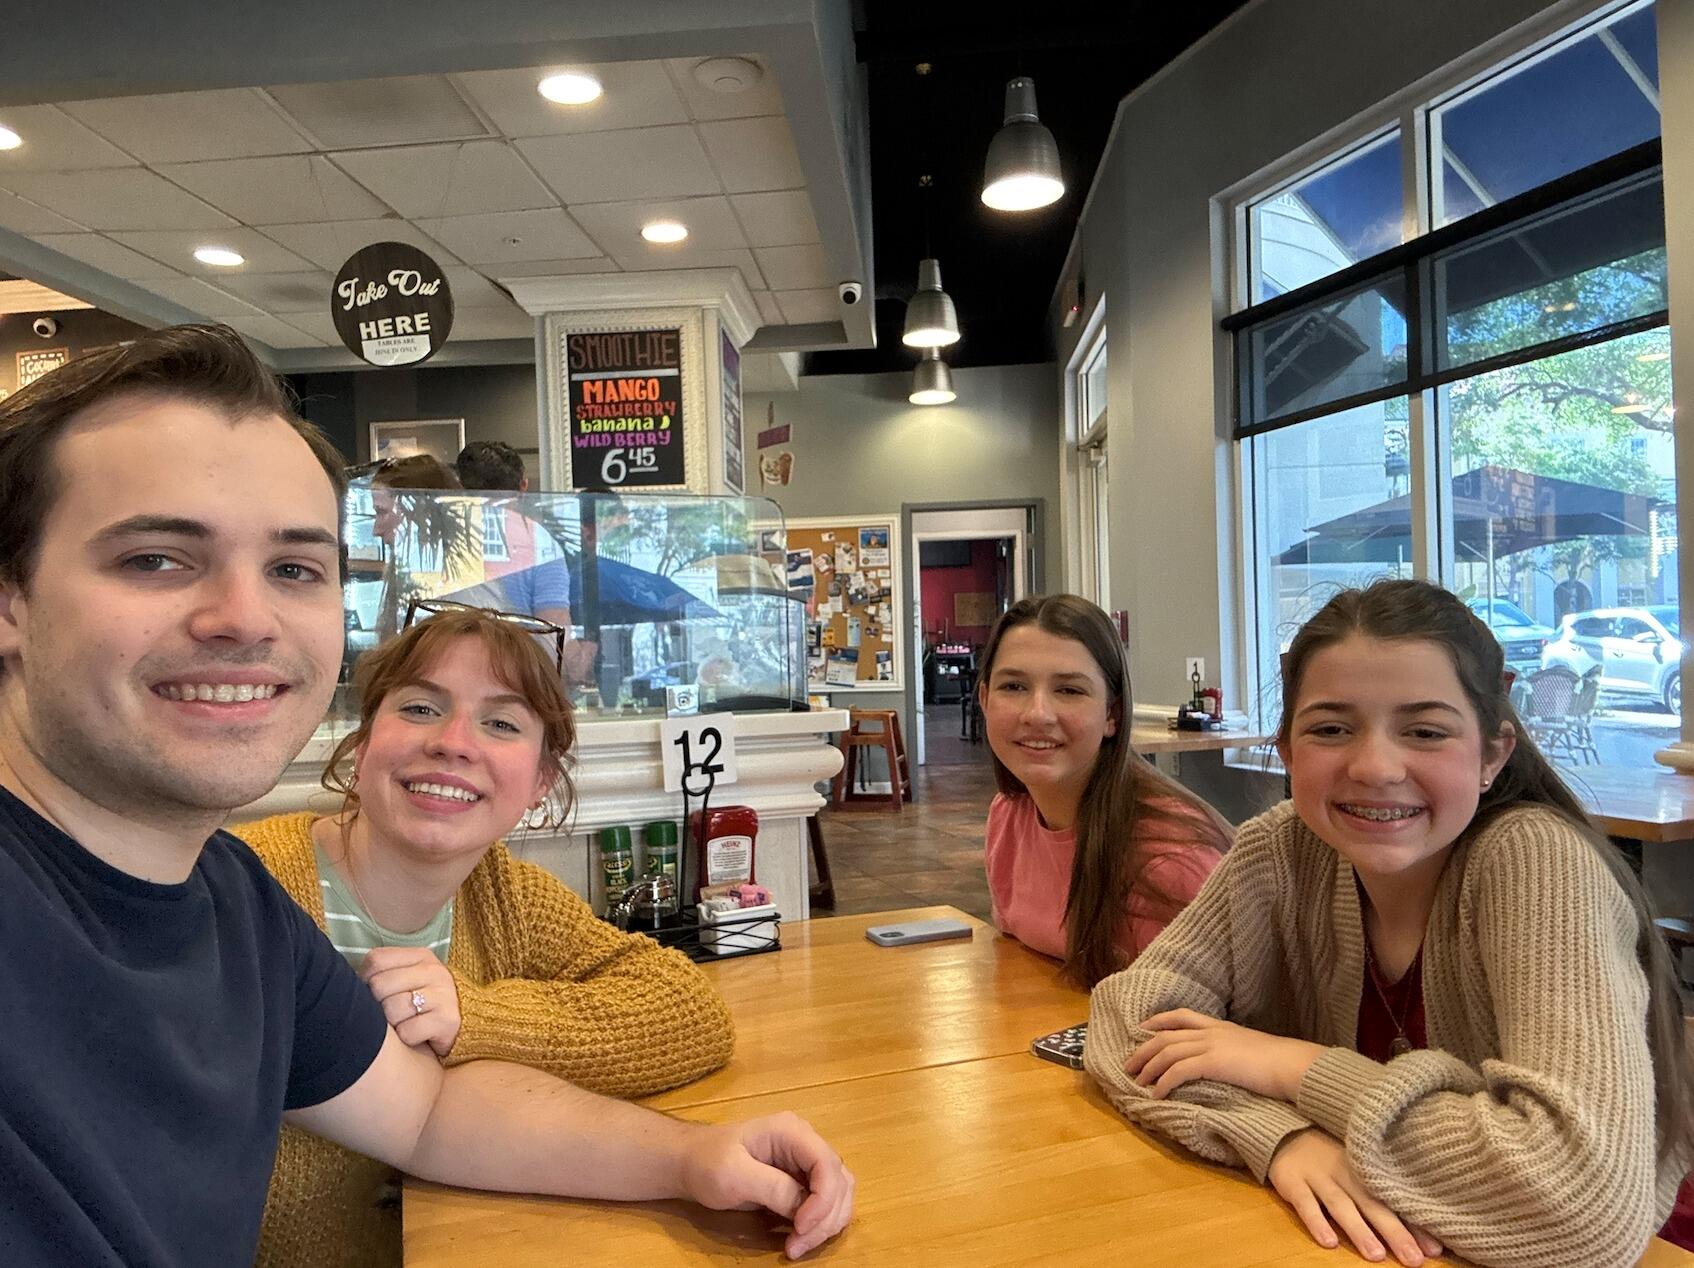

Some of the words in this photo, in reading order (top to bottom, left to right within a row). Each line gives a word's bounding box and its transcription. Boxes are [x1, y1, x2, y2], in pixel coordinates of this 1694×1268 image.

[338, 278, 388, 311] Take
[388, 269, 440, 296] Out
[359, 312, 431, 339] HERE
[569, 334, 677, 369] SMOOTHIE
[582, 378, 660, 403] MANGO
[576, 401, 676, 420] STRAWBERRY
[580, 418, 654, 433] banana
[574, 434, 612, 449] WILD
[614, 430, 672, 447] BERRY
[674, 727, 724, 777] 12
[721, 840, 741, 849] HEINZ
